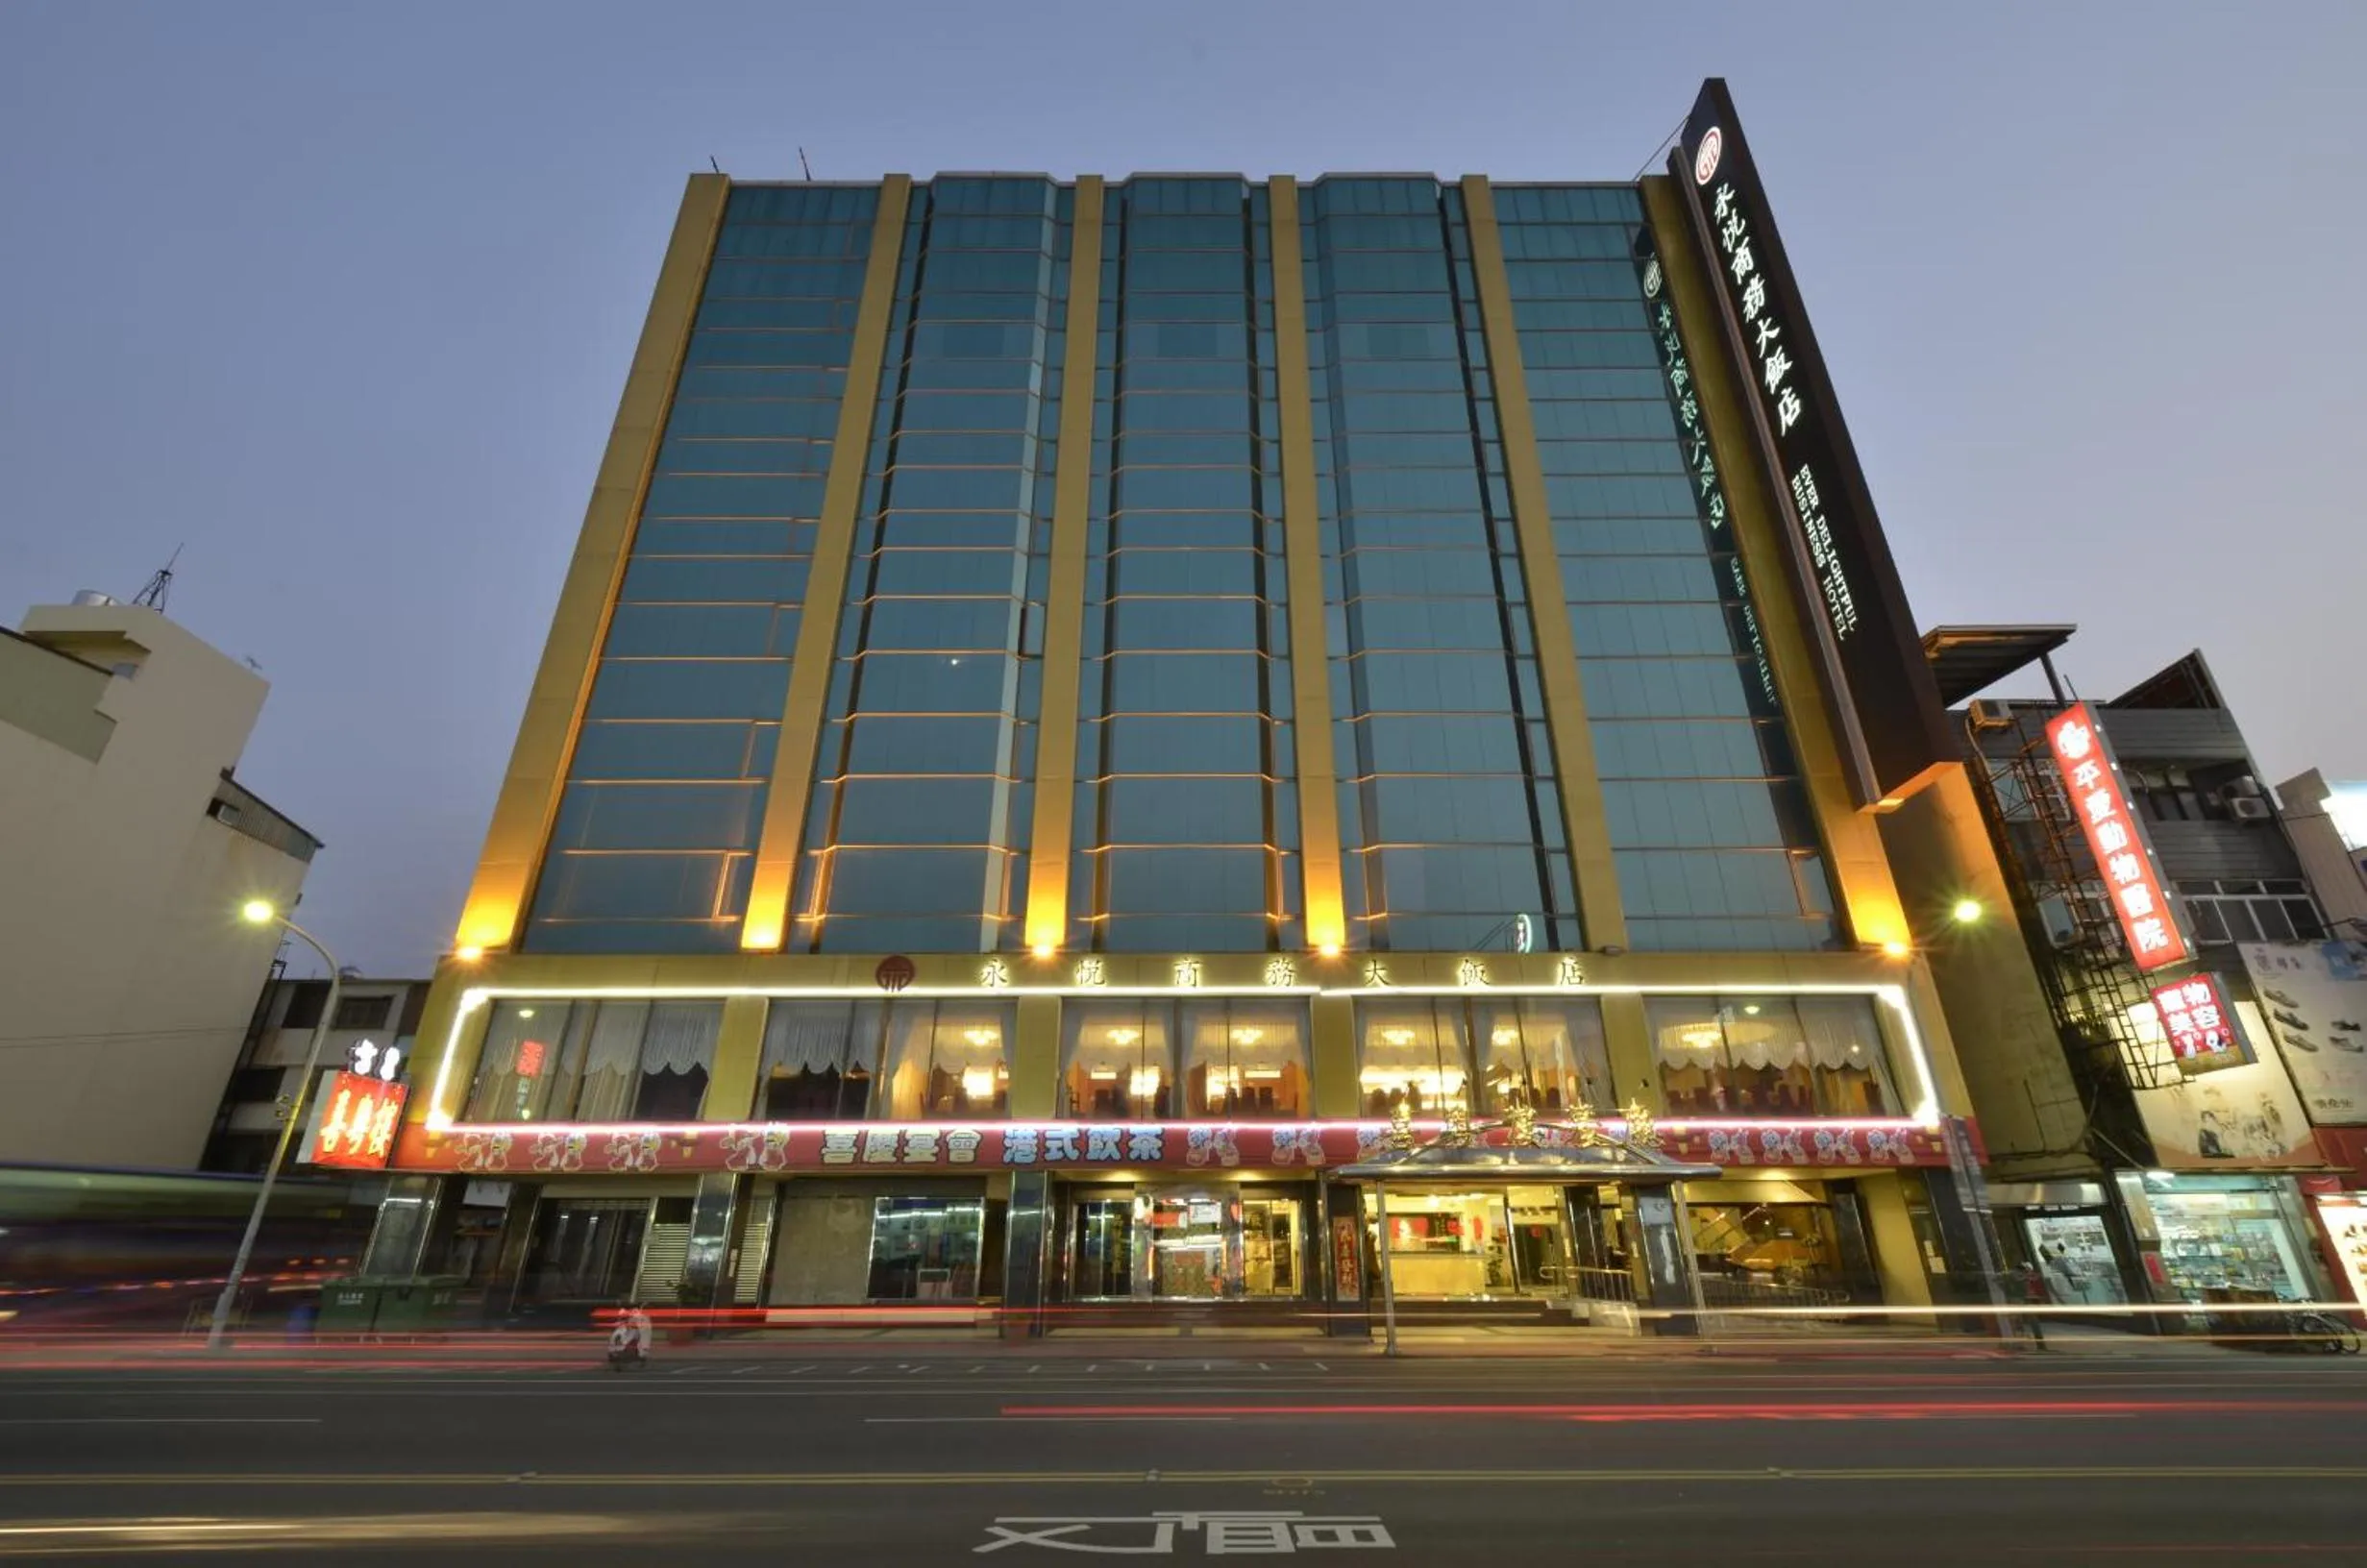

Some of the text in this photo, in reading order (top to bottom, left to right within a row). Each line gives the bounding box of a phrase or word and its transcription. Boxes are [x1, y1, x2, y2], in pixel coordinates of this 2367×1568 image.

[1791, 475, 1845, 641] BUSINESS HOTEL
[1799, 463, 1859, 632] EVER DELIGHTFUL
[1002, 1126, 1164, 1164] 港式飲茶
